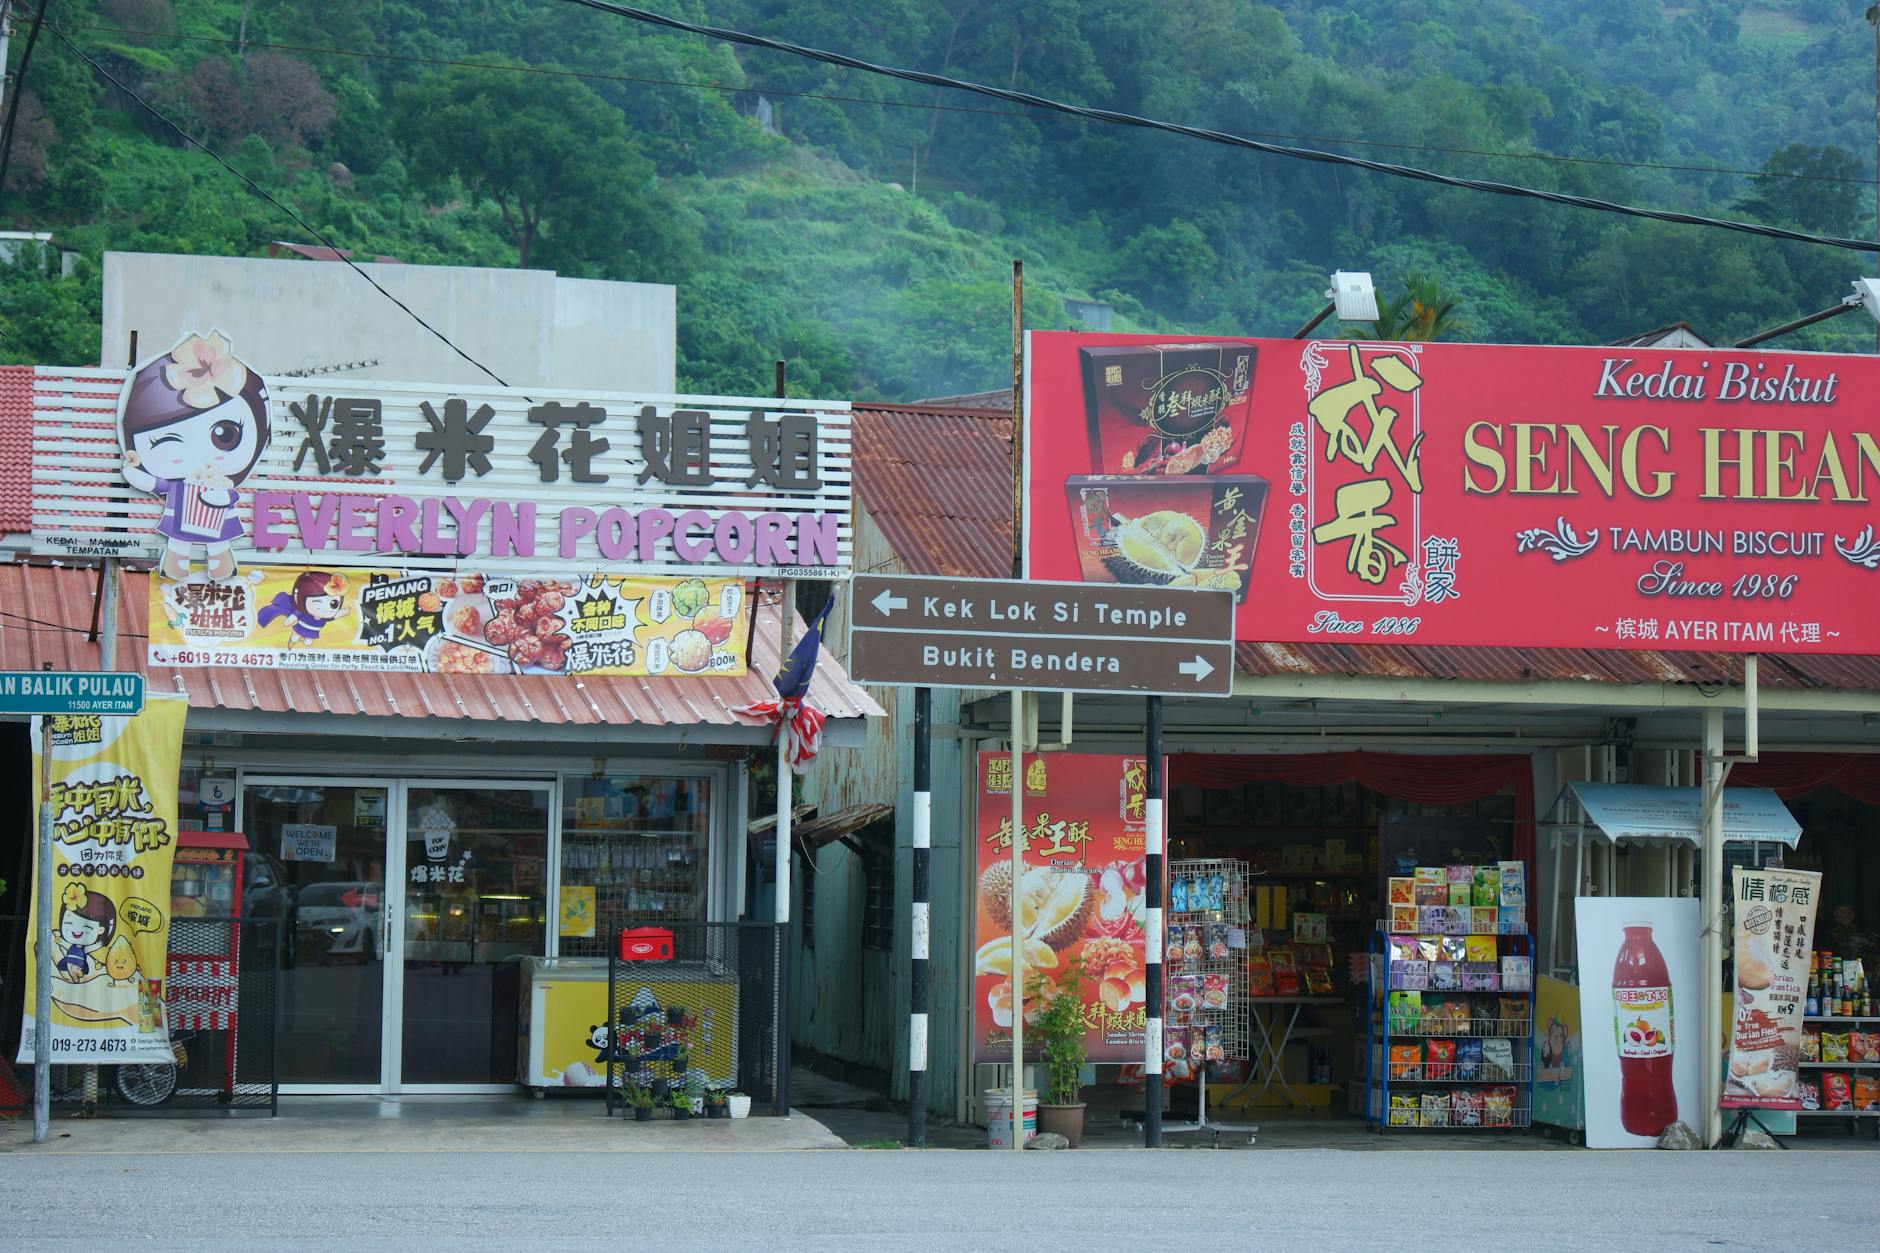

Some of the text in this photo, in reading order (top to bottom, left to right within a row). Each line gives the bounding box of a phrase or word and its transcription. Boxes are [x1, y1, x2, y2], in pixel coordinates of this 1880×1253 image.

[1594, 358, 1838, 403] Kedai Biskut
[289, 393, 823, 490] 爆米花姐姐
[1463, 420, 1676, 498] SENG
[253, 491, 839, 567] EVERLYN POPCORN
[46, 537, 140, 547] KEDAI MAKANAN
[66, 546, 119, 555] TEMPATAN
[1610, 526, 1825, 556] TAMBUN BISCUIT
[777, 568, 840, 578] (PG0355861-K)
[1422, 534, 1461, 603] 餅家
[365, 578, 428, 602] PENANG
[1637, 561, 1799, 599] Since 1986
[189, 607, 235, 629] 姐姐
[376, 597, 416, 625] 槟城
[582, 600, 611, 616] 各种
[923, 597, 1187, 629] Kek Lok Si Temple
[571, 614, 627, 634] 不同口味
[1307, 609, 1421, 636] Since 1986
[1615, 617, 1821, 644] 槟城 AYER ITAM 代理
[170, 651, 273, 666] +6019 273 4673
[565, 639, 635, 673] 爆米花
[709, 654, 736, 668] BOOM
[923, 645, 1120, 673] Bukit Bendera
[21, 676, 74, 696] BALIK
[78, 677, 136, 697] PULAU
[68, 700, 134, 710] 11500 AYER ITAM
[73, 727, 102, 744] 姐姐
[1113, 836, 1133, 846] SENG
[81, 849, 124, 862] 因为你是
[295, 846, 324, 857] OPEN
[1050, 858, 1075, 867] Durian
[410, 866, 465, 883] 爆米花
[1736, 1029, 1760, 1040] Durian
[52, 1038, 97, 1052] 019-273
[100, 1038, 127, 1052] 4673
